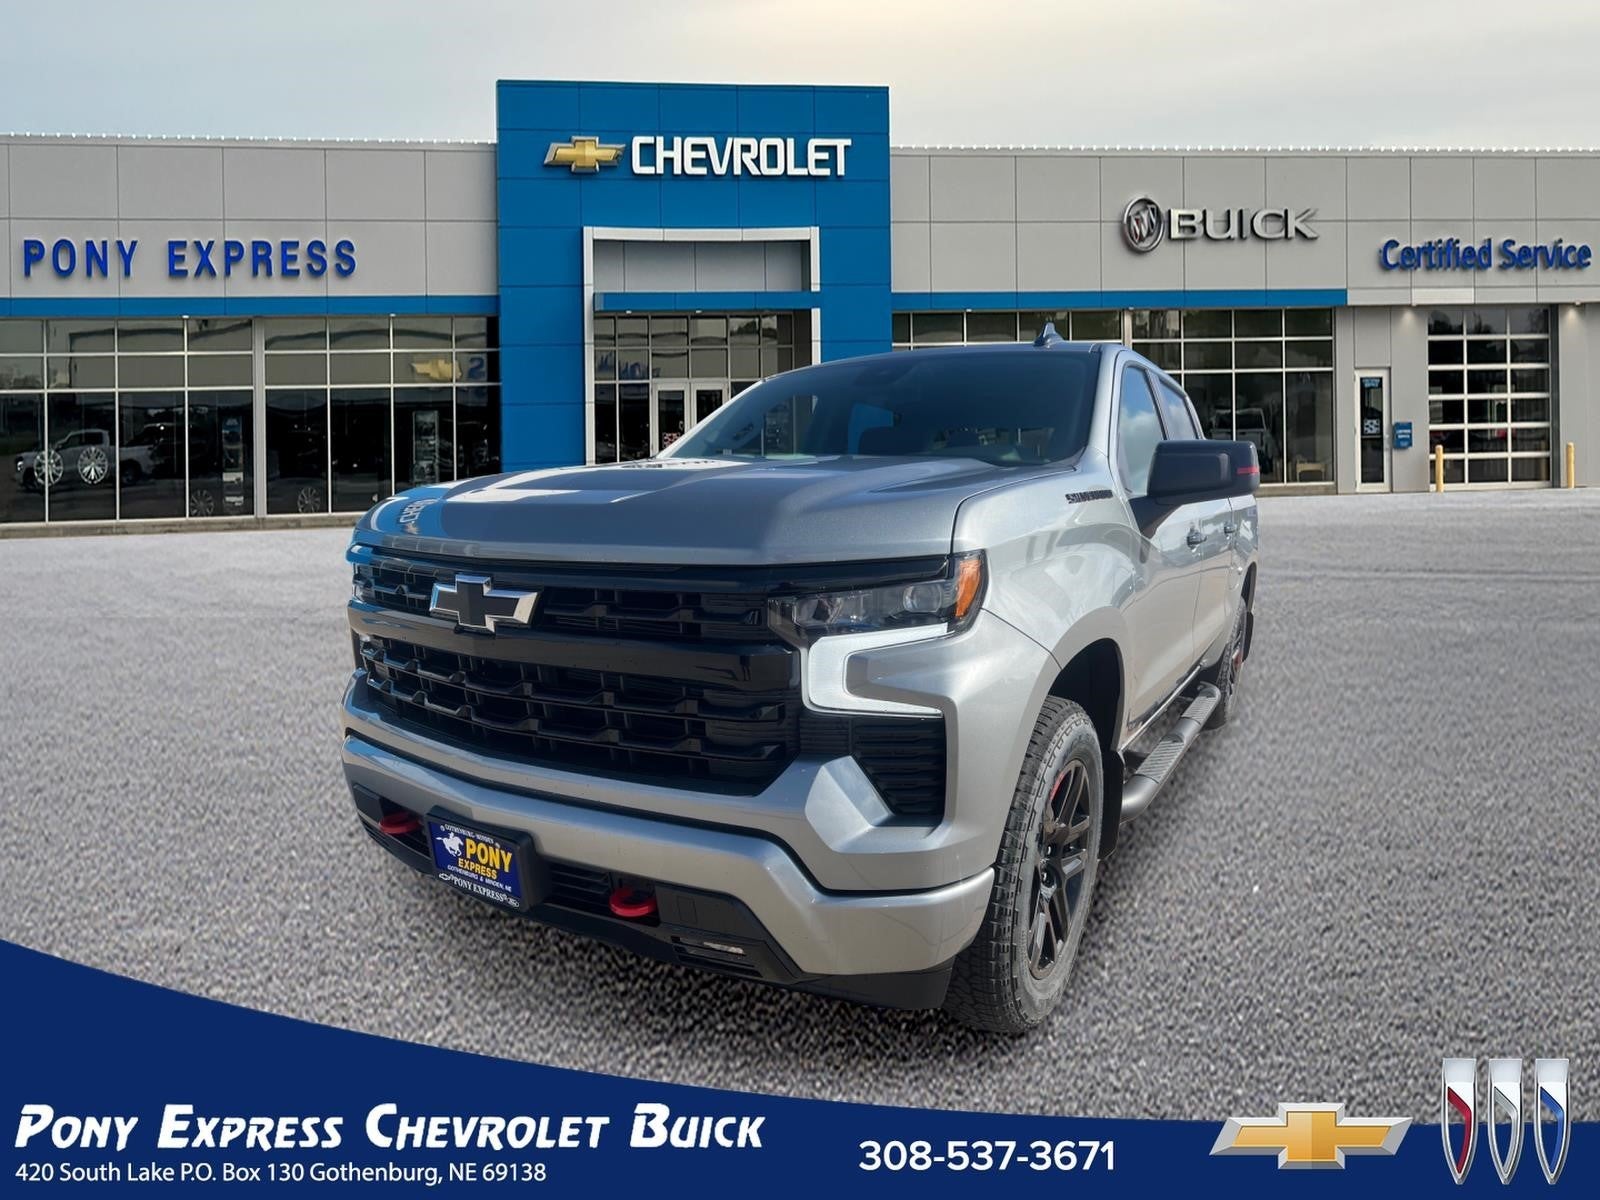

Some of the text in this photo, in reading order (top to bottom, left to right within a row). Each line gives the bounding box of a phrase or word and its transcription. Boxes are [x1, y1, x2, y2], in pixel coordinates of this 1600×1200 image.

[631, 135, 852, 176] CHEVROLET
[1168, 207, 1319, 241] BUICK
[23, 239, 358, 278] PONY EXPRESS
[1380, 239, 1592, 270] Certified Service
[458, 857, 498, 880] EXPRESS
[465, 838, 512, 873] PONY
[453, 876, 473, 891] PONY
